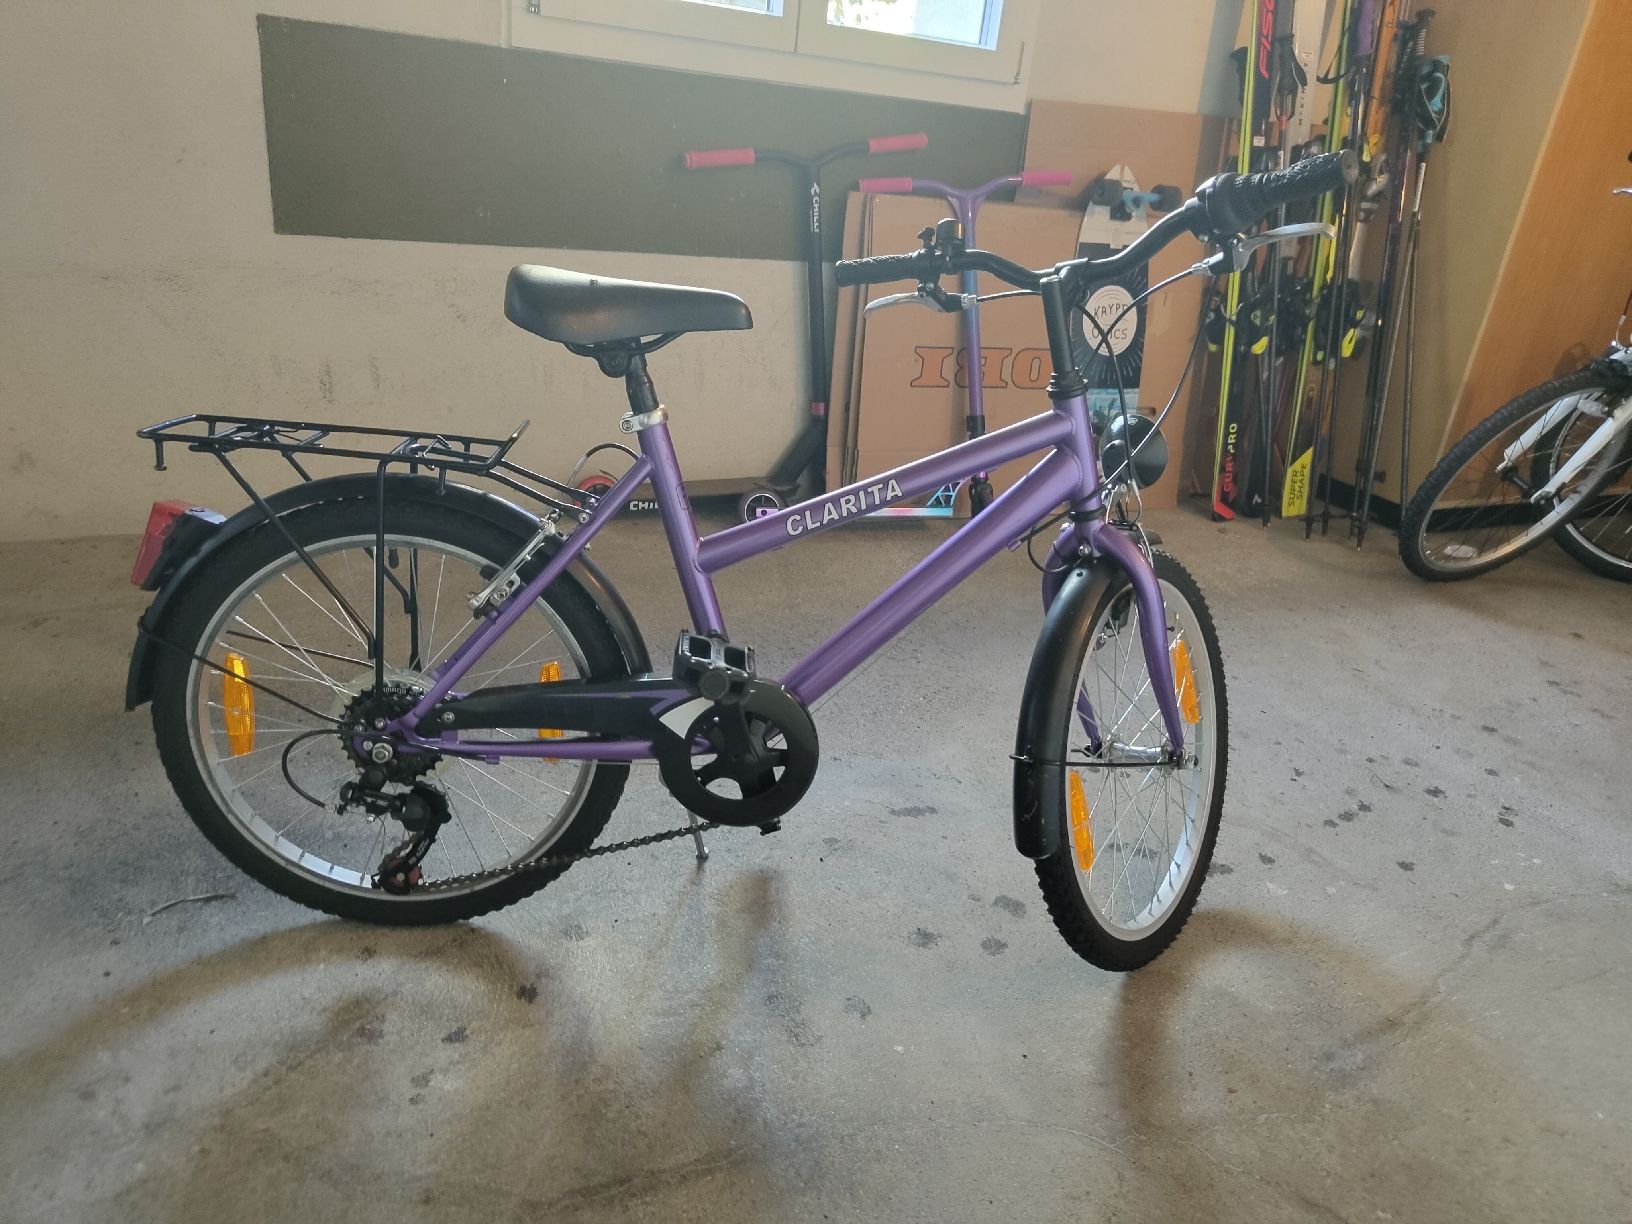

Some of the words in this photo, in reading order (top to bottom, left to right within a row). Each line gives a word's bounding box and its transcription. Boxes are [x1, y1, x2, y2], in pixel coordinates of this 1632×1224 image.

[812, 196, 820, 232] CHILLI
[1091, 326, 1128, 340] OICS
[1288, 469, 1300, 507] SUPER
[1296, 462, 1307, 501] SHAPE
[786, 478, 903, 536] CLARITA
